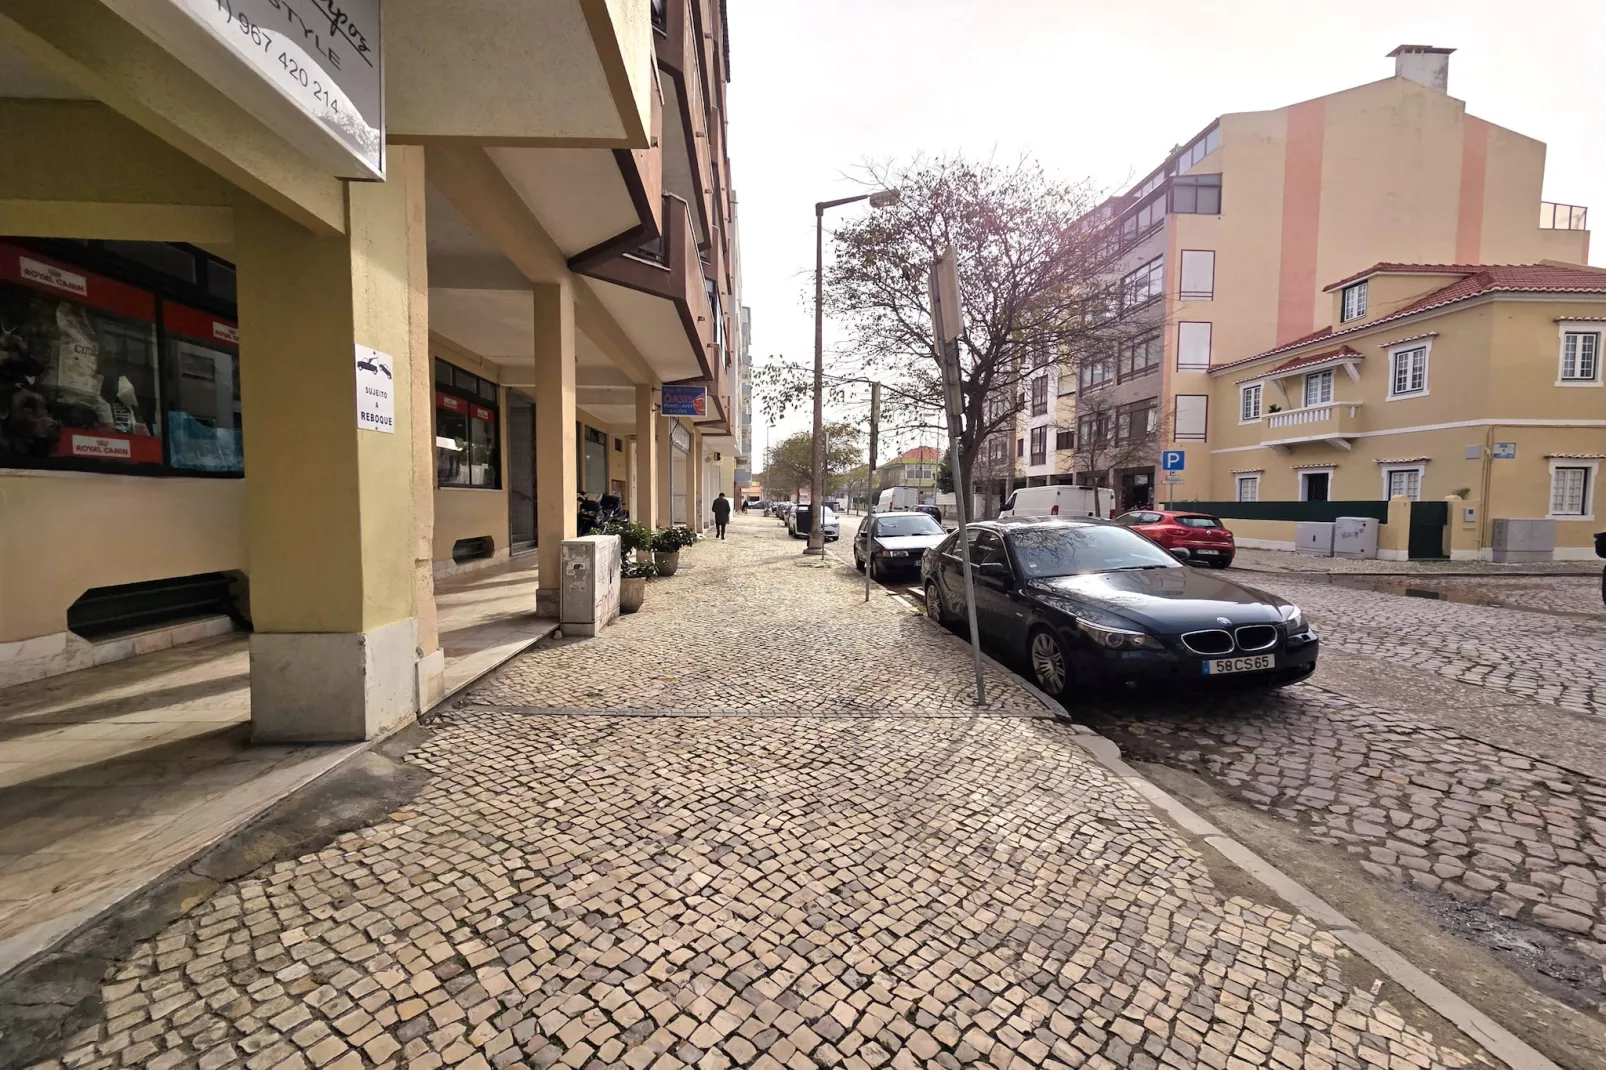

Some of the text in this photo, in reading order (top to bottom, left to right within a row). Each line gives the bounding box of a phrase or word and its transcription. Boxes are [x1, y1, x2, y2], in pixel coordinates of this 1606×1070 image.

[238, 12, 273, 53] 967
[278, 52, 308, 88] 420
[313, 80, 340, 115] 214
[24, 267, 84, 292] ROYAL CANIN
[365, 386, 388, 399] SUJEITO
[360, 411, 393, 426] REBOQUE
[76, 444, 128, 455] ROYAL CANIN
[1167, 452, 1180, 469] P
